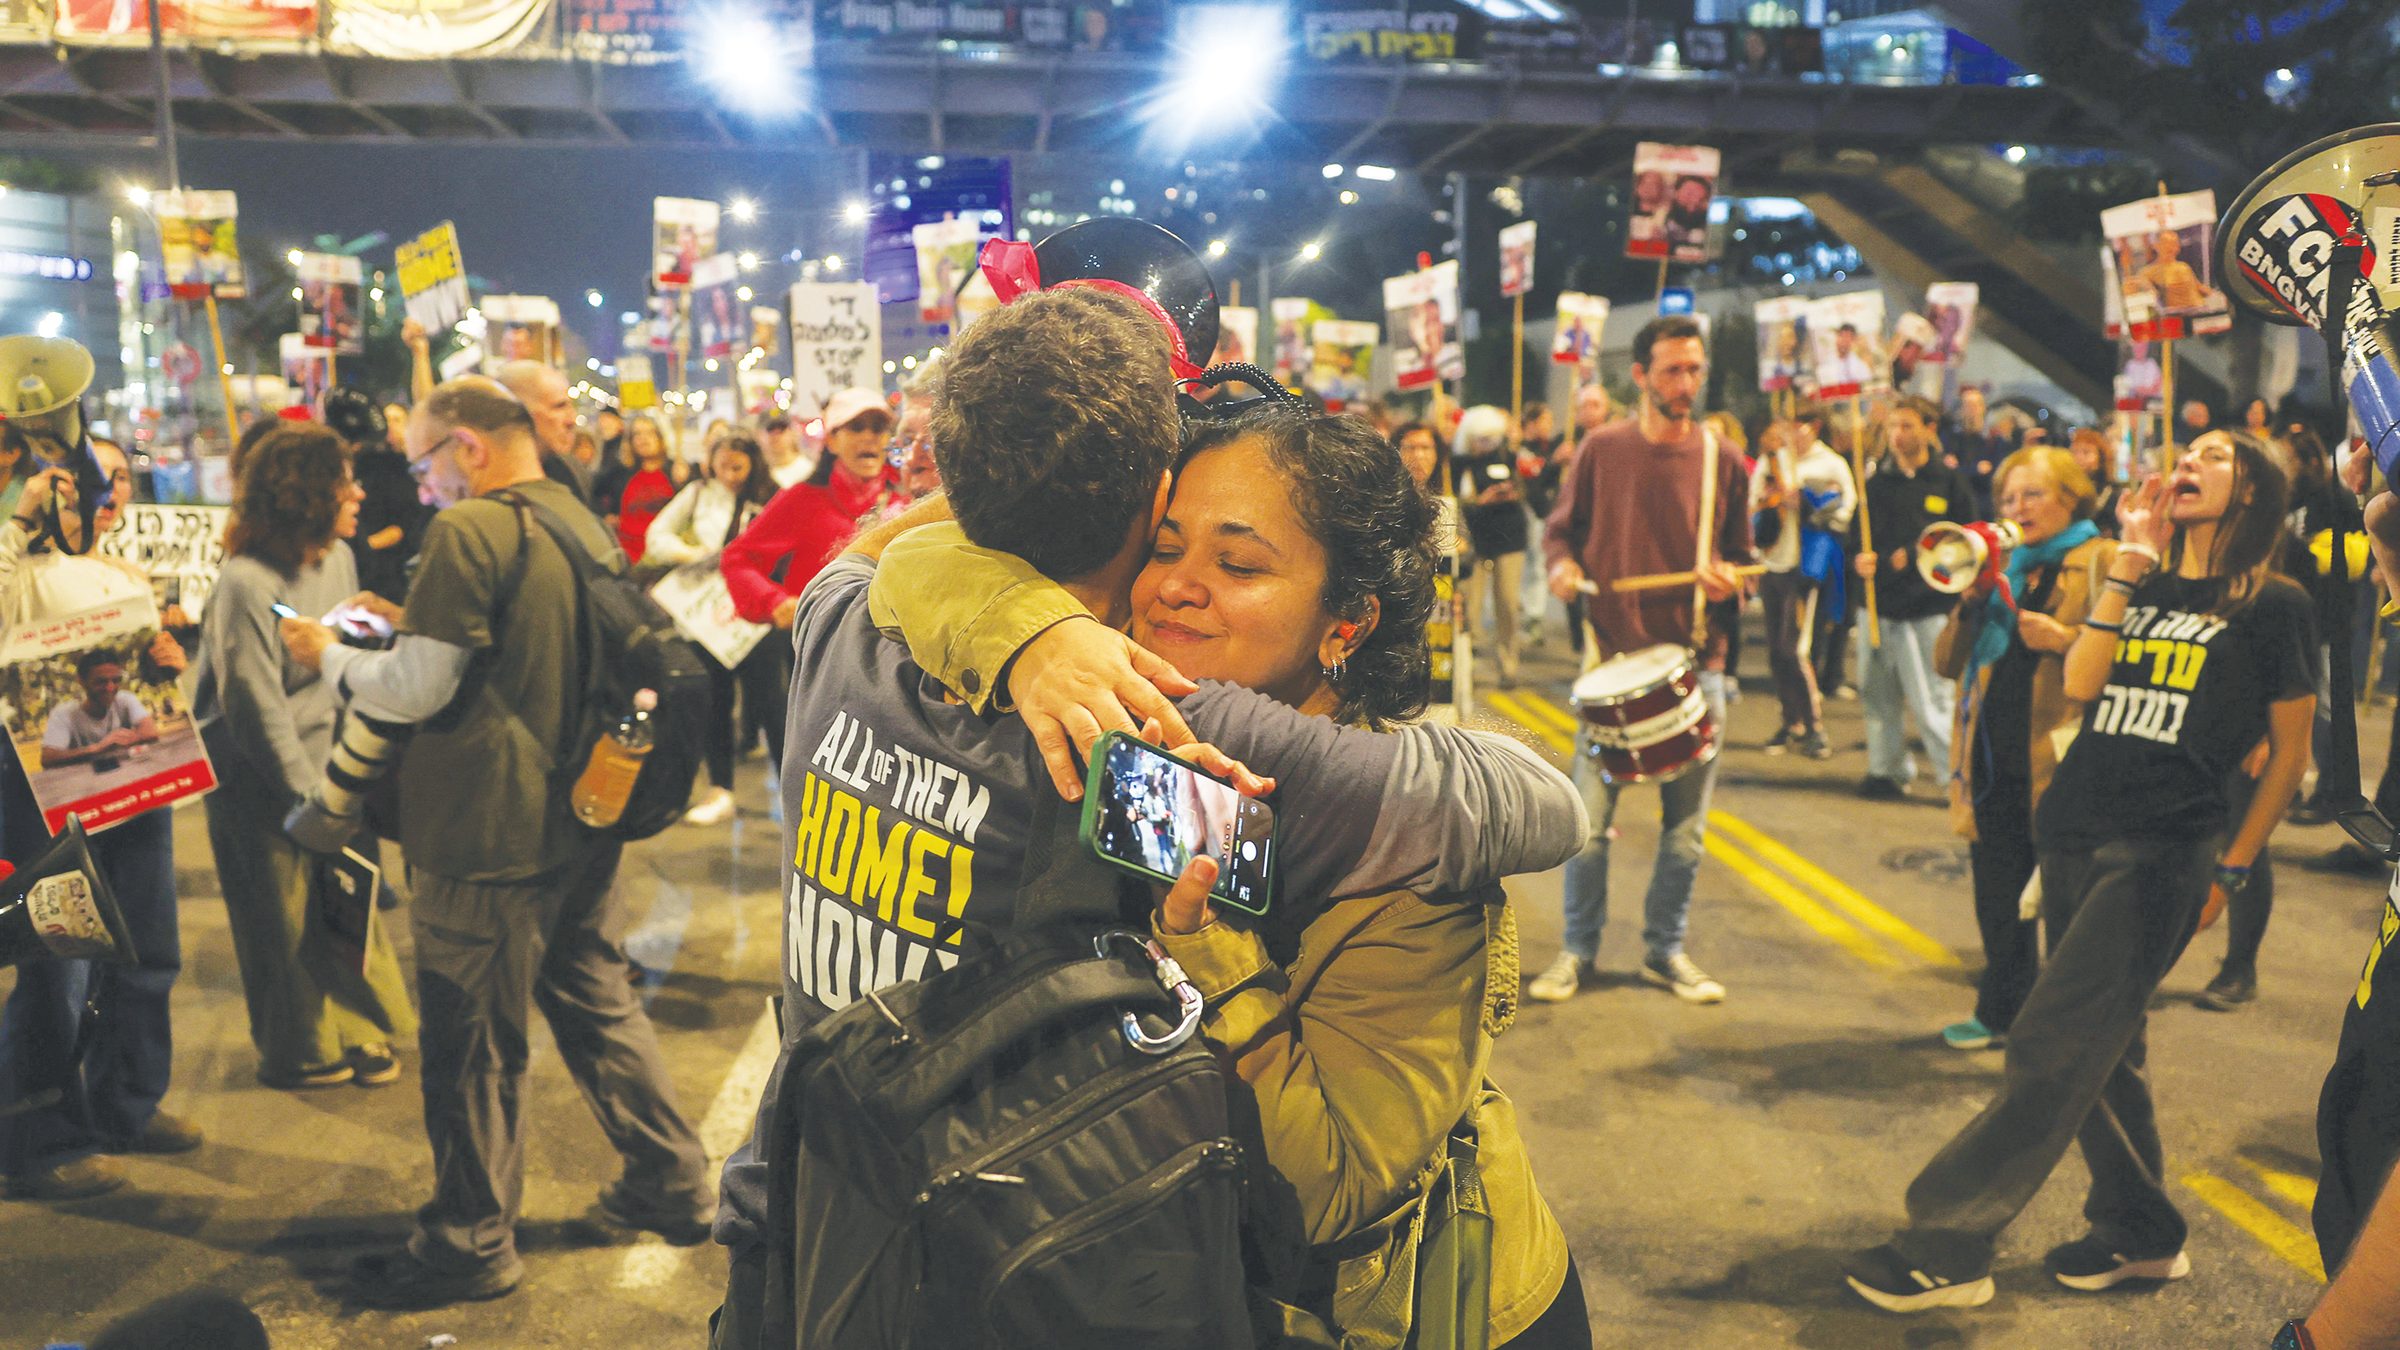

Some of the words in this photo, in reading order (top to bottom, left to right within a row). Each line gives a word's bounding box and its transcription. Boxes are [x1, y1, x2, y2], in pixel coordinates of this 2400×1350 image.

[814, 346, 864, 366] STOP
[2115, 638, 2208, 692] עדיי
[2093, 684, 2189, 744] בעזה
[811, 710, 874, 793] ALL
[870, 746, 896, 787] OF
[889, 743, 991, 845] THEM
[794, 770, 975, 947] HOME!
[788, 871, 960, 1012] NOW
